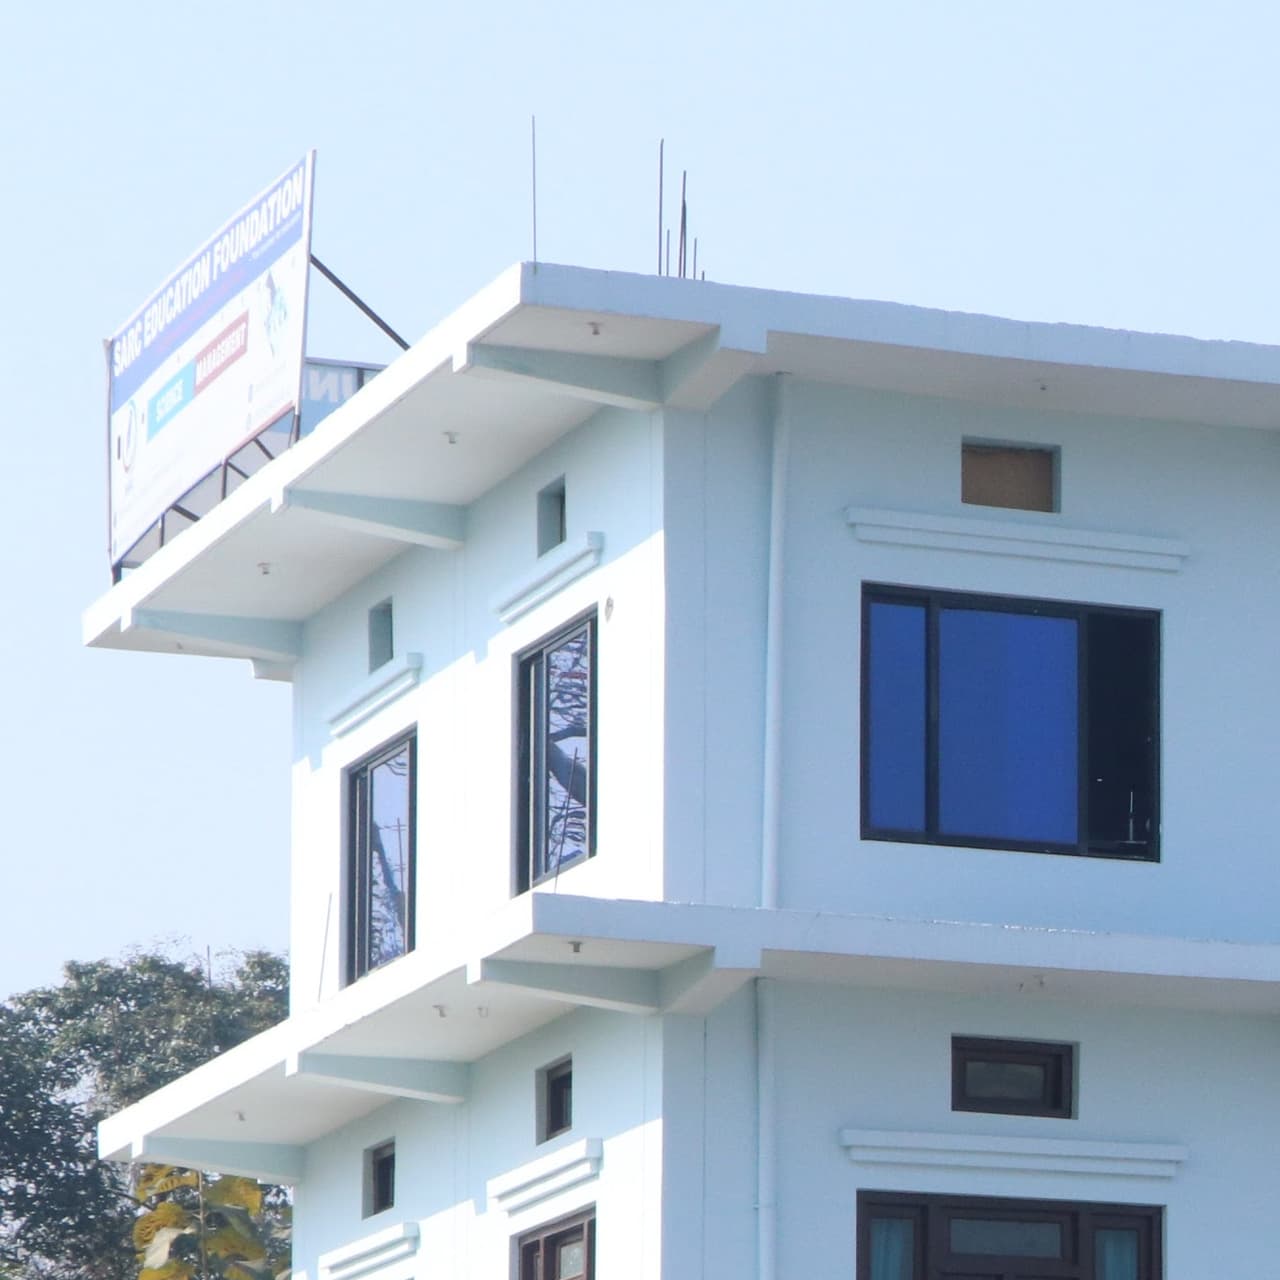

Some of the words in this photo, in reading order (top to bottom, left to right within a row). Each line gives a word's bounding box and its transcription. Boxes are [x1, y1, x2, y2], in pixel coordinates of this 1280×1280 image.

[114, 321, 143, 377] SARC
[144, 251, 211, 349] EDUCATION
[213, 166, 304, 281] FOUNDATION
